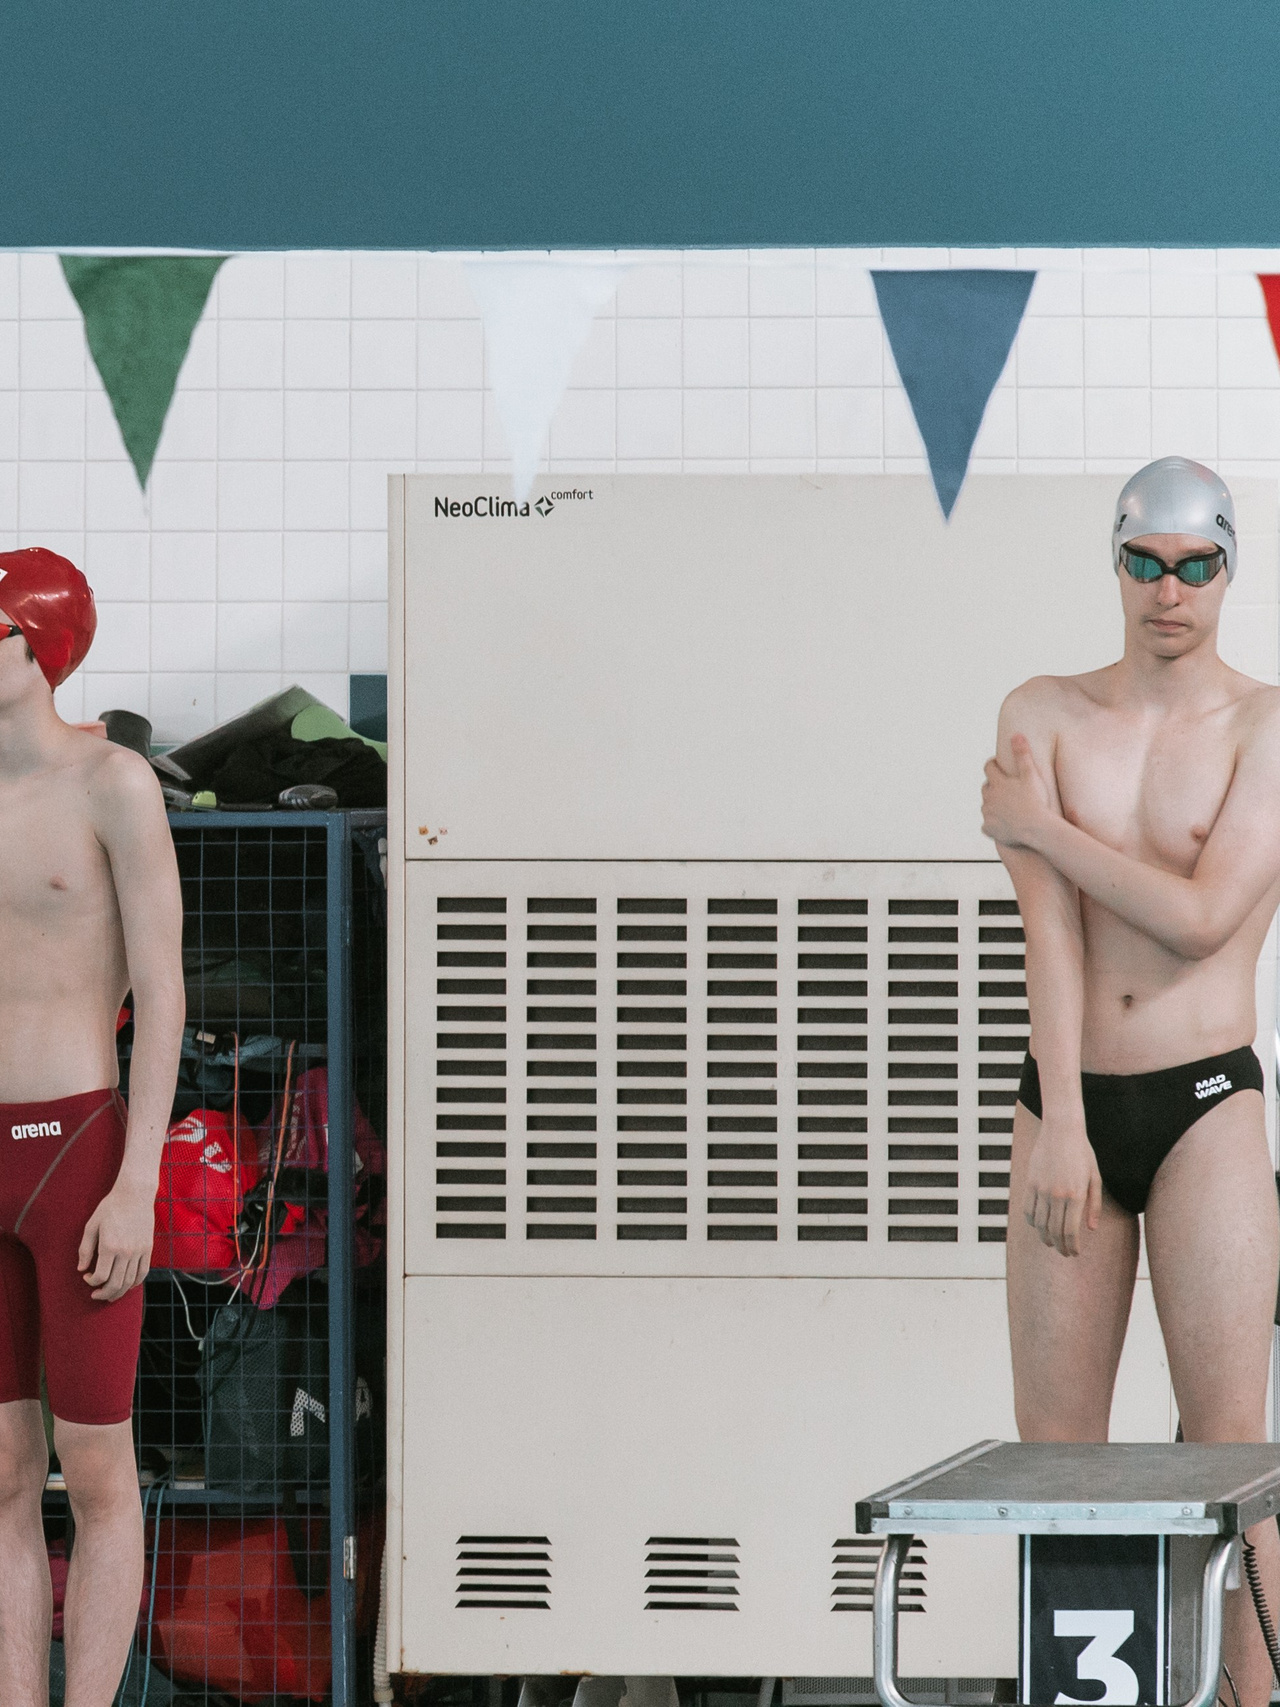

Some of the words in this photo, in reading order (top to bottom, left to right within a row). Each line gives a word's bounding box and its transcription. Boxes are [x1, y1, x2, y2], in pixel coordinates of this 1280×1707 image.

[434, 496, 530, 518] NeoClima
[551, 489, 594, 500] comfort
[1215, 513, 1236, 538] are
[1194, 1080, 1233, 1099] WAVE
[1195, 1074, 1226, 1091] MAD
[11, 1121, 62, 1140] arena
[1053, 1609, 1139, 1706] 3
